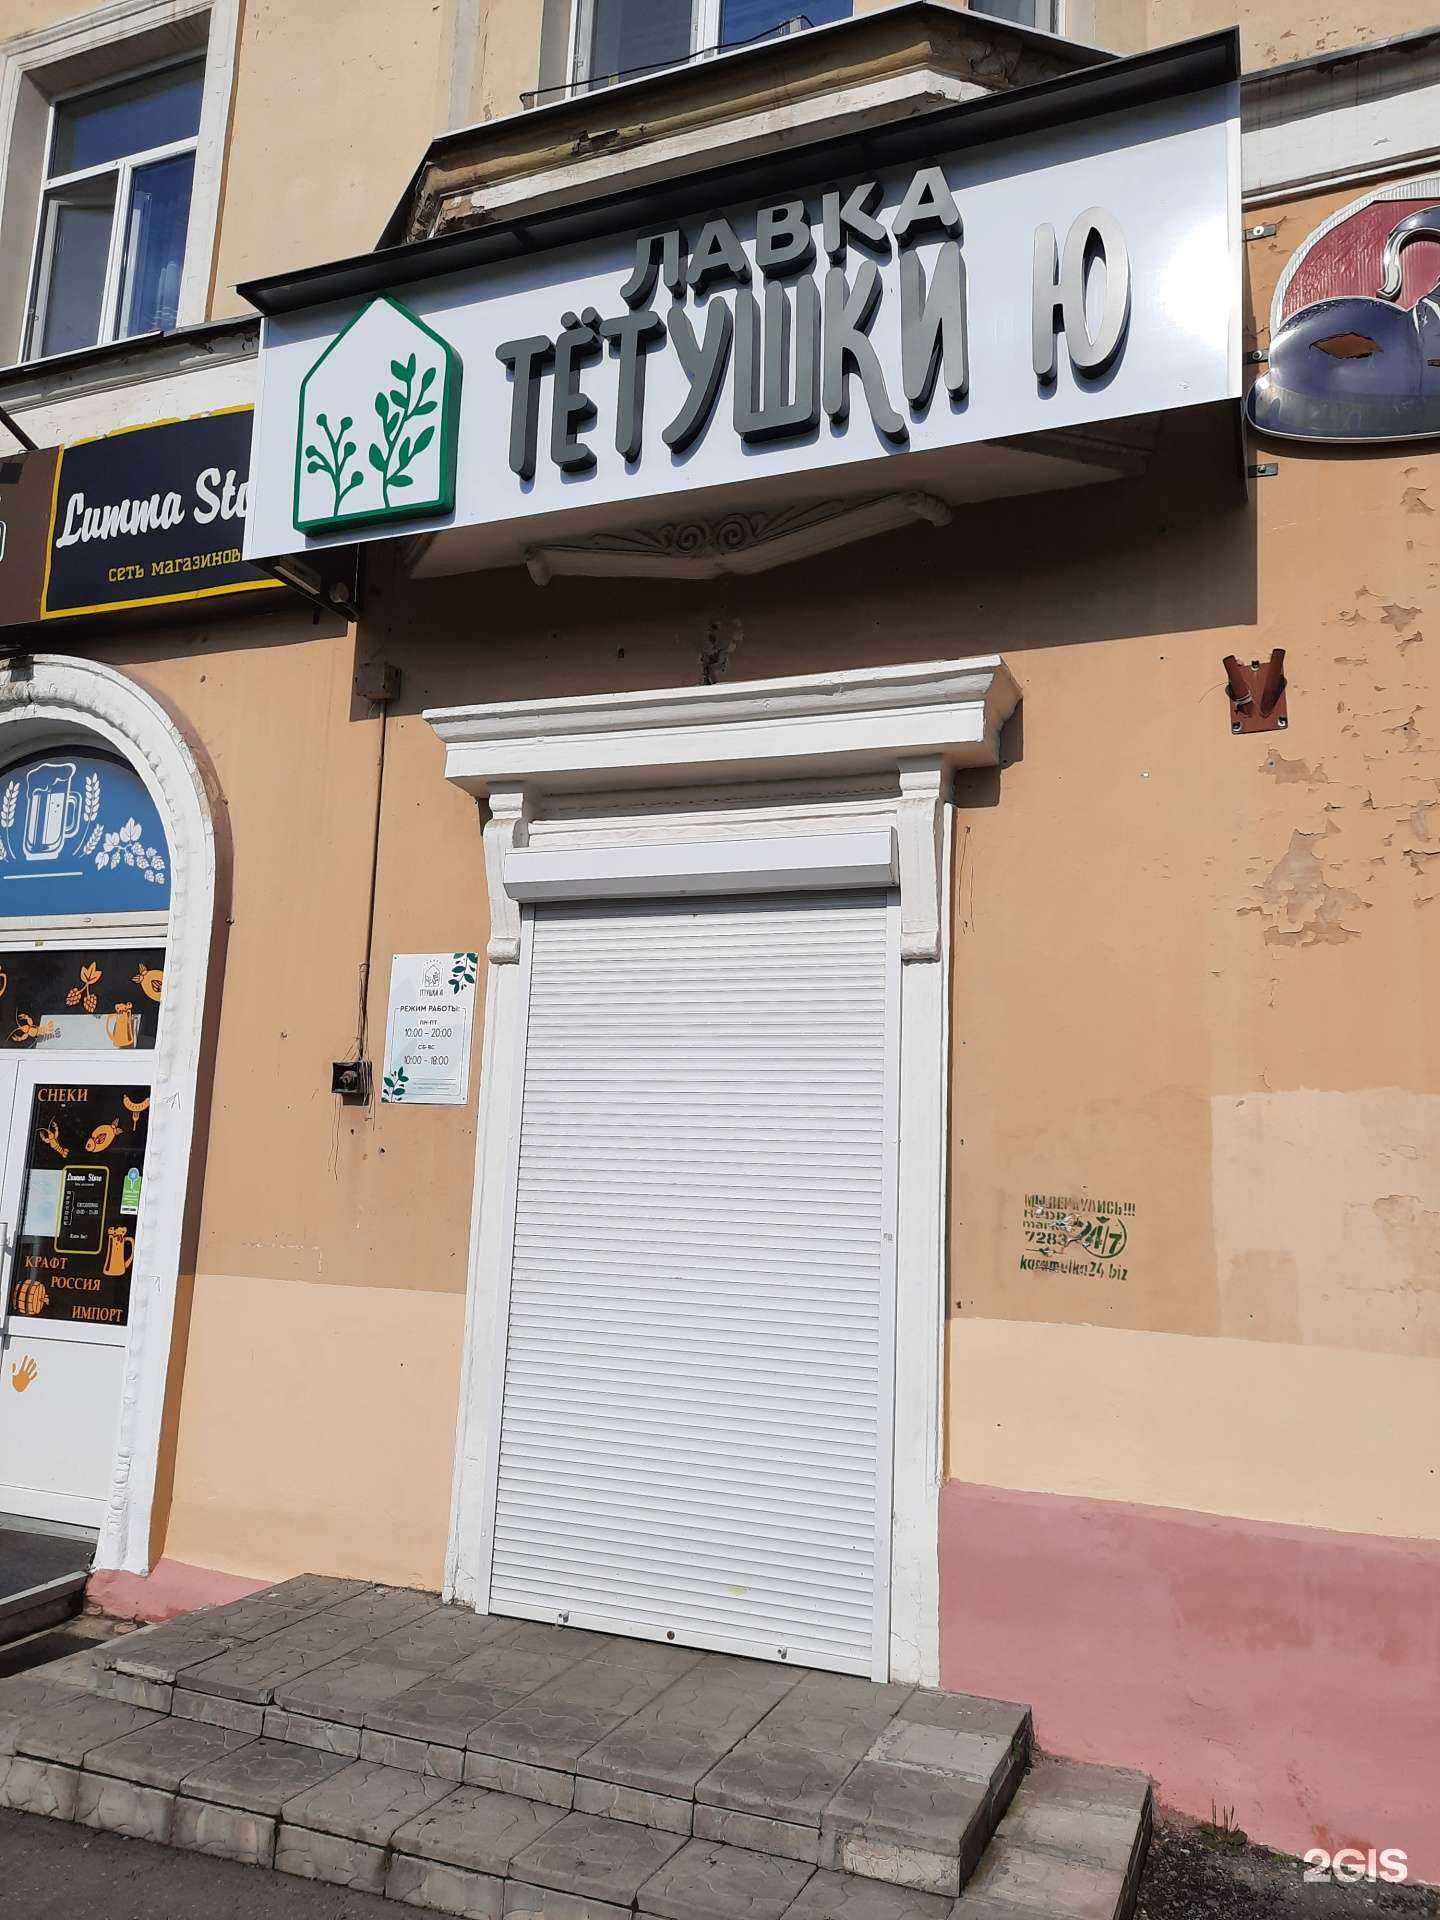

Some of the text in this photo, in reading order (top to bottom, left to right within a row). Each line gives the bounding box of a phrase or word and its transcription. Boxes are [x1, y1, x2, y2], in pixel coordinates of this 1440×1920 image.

[620, 165, 963, 308] ЛАВКА
[495, 206, 1131, 482] ТЁТУШКИ Ю
[55, 491, 185, 549] Lumma
[108, 548, 242, 582] сеть магазинов
[37, 1088, 89, 1102] СНЕКИ
[25, 1255, 69, 1270] КРАФТ
[50, 1276, 102, 1292] РОССИЯ
[71, 1305, 123, 1323] ИМПОРТ
